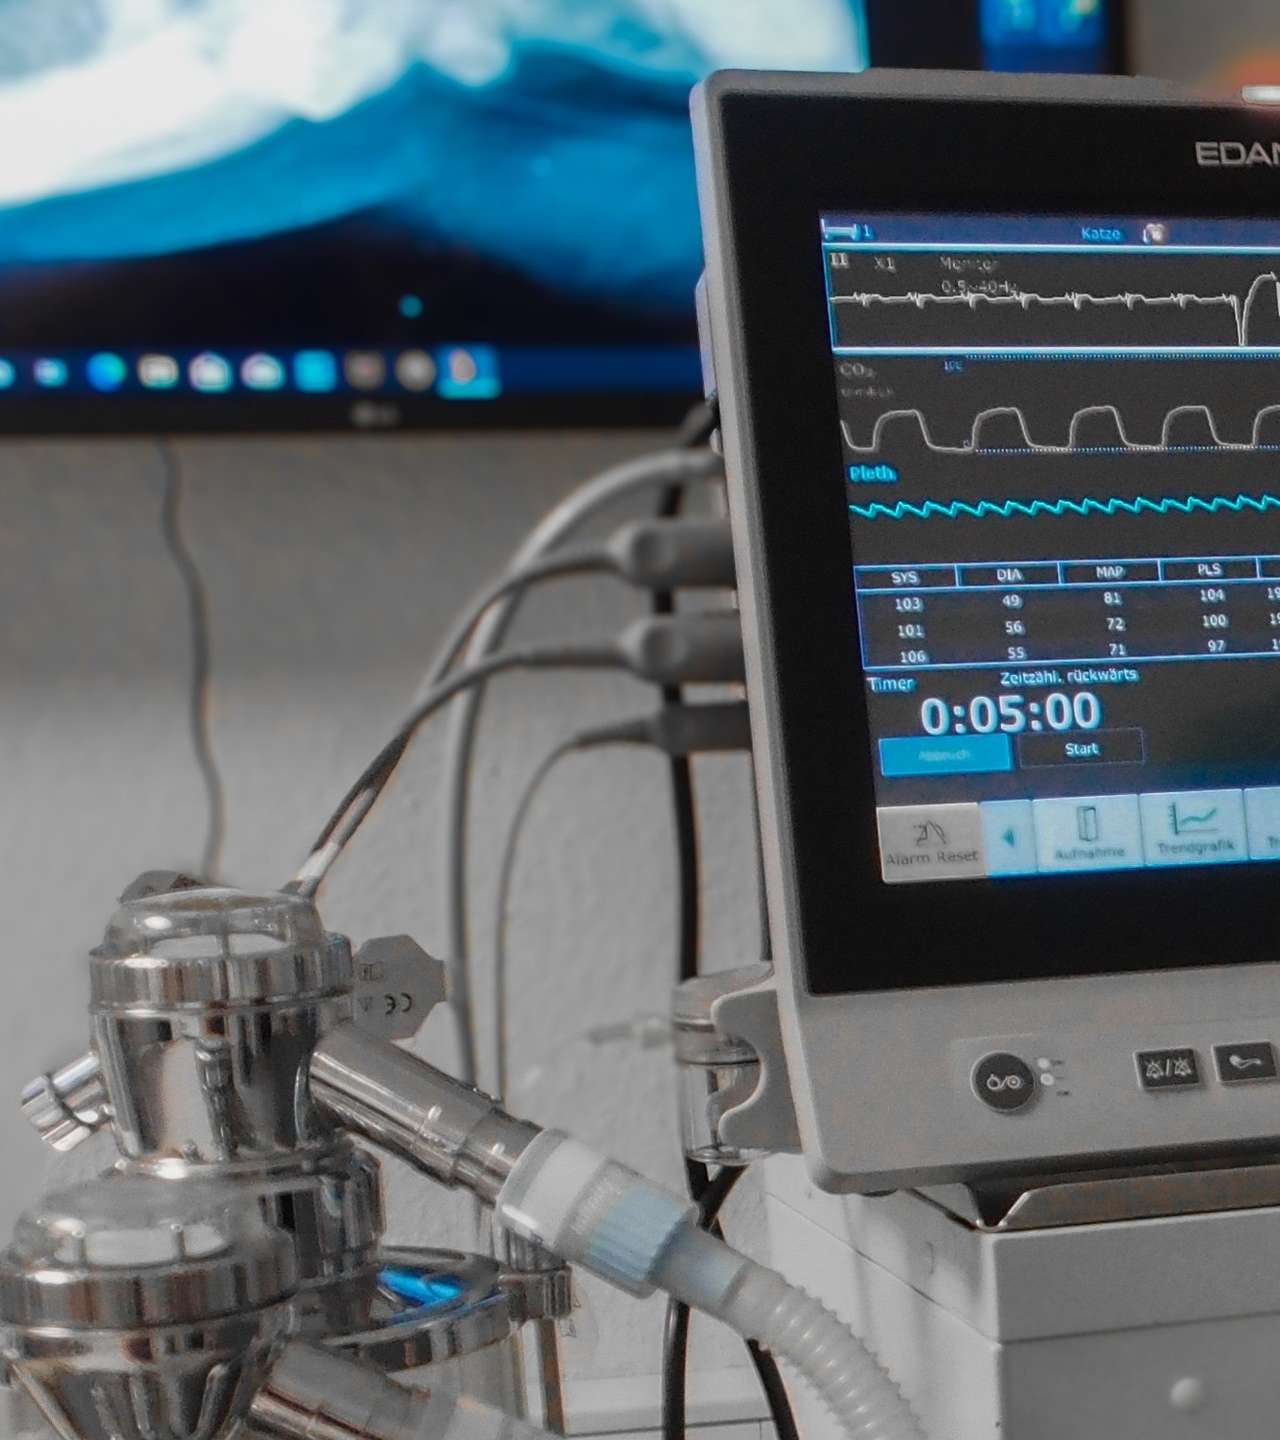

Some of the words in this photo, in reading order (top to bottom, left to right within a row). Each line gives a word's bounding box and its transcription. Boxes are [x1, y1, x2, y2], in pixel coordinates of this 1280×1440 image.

[1081, 227, 1122, 241] Katze
[849, 465, 897, 482] Pleth
[996, 568, 1023, 582] DIA
[1096, 565, 1125, 579] MAP
[1198, 562, 1222, 576] PLS
[891, 571, 920, 585] SYS
[895, 597, 923, 611] 103
[1003, 594, 1023, 608] 49
[1104, 591, 1123, 605] 81
[1200, 588, 1226, 602] 104
[898, 624, 925, 638] 101
[1005, 620, 1025, 634] 56
[1107, 617, 1126, 631] 72
[1203, 614, 1229, 628] 100
[900, 650, 928, 664] 106
[1008, 647, 1027, 660] 55
[1109, 643, 1127, 657] 71
[1208, 640, 1225, 653] 97
[866, 675, 915, 692] Timer
[1000, 670, 1062, 685] Zeitzähl.
[1067, 667, 1138, 683] rückwärts
[921, 691, 1101, 736] 0:05:00
[1065, 742, 1100, 756] Start
[886, 850, 930, 866] Alarm
[936, 848, 979, 863] Reset
